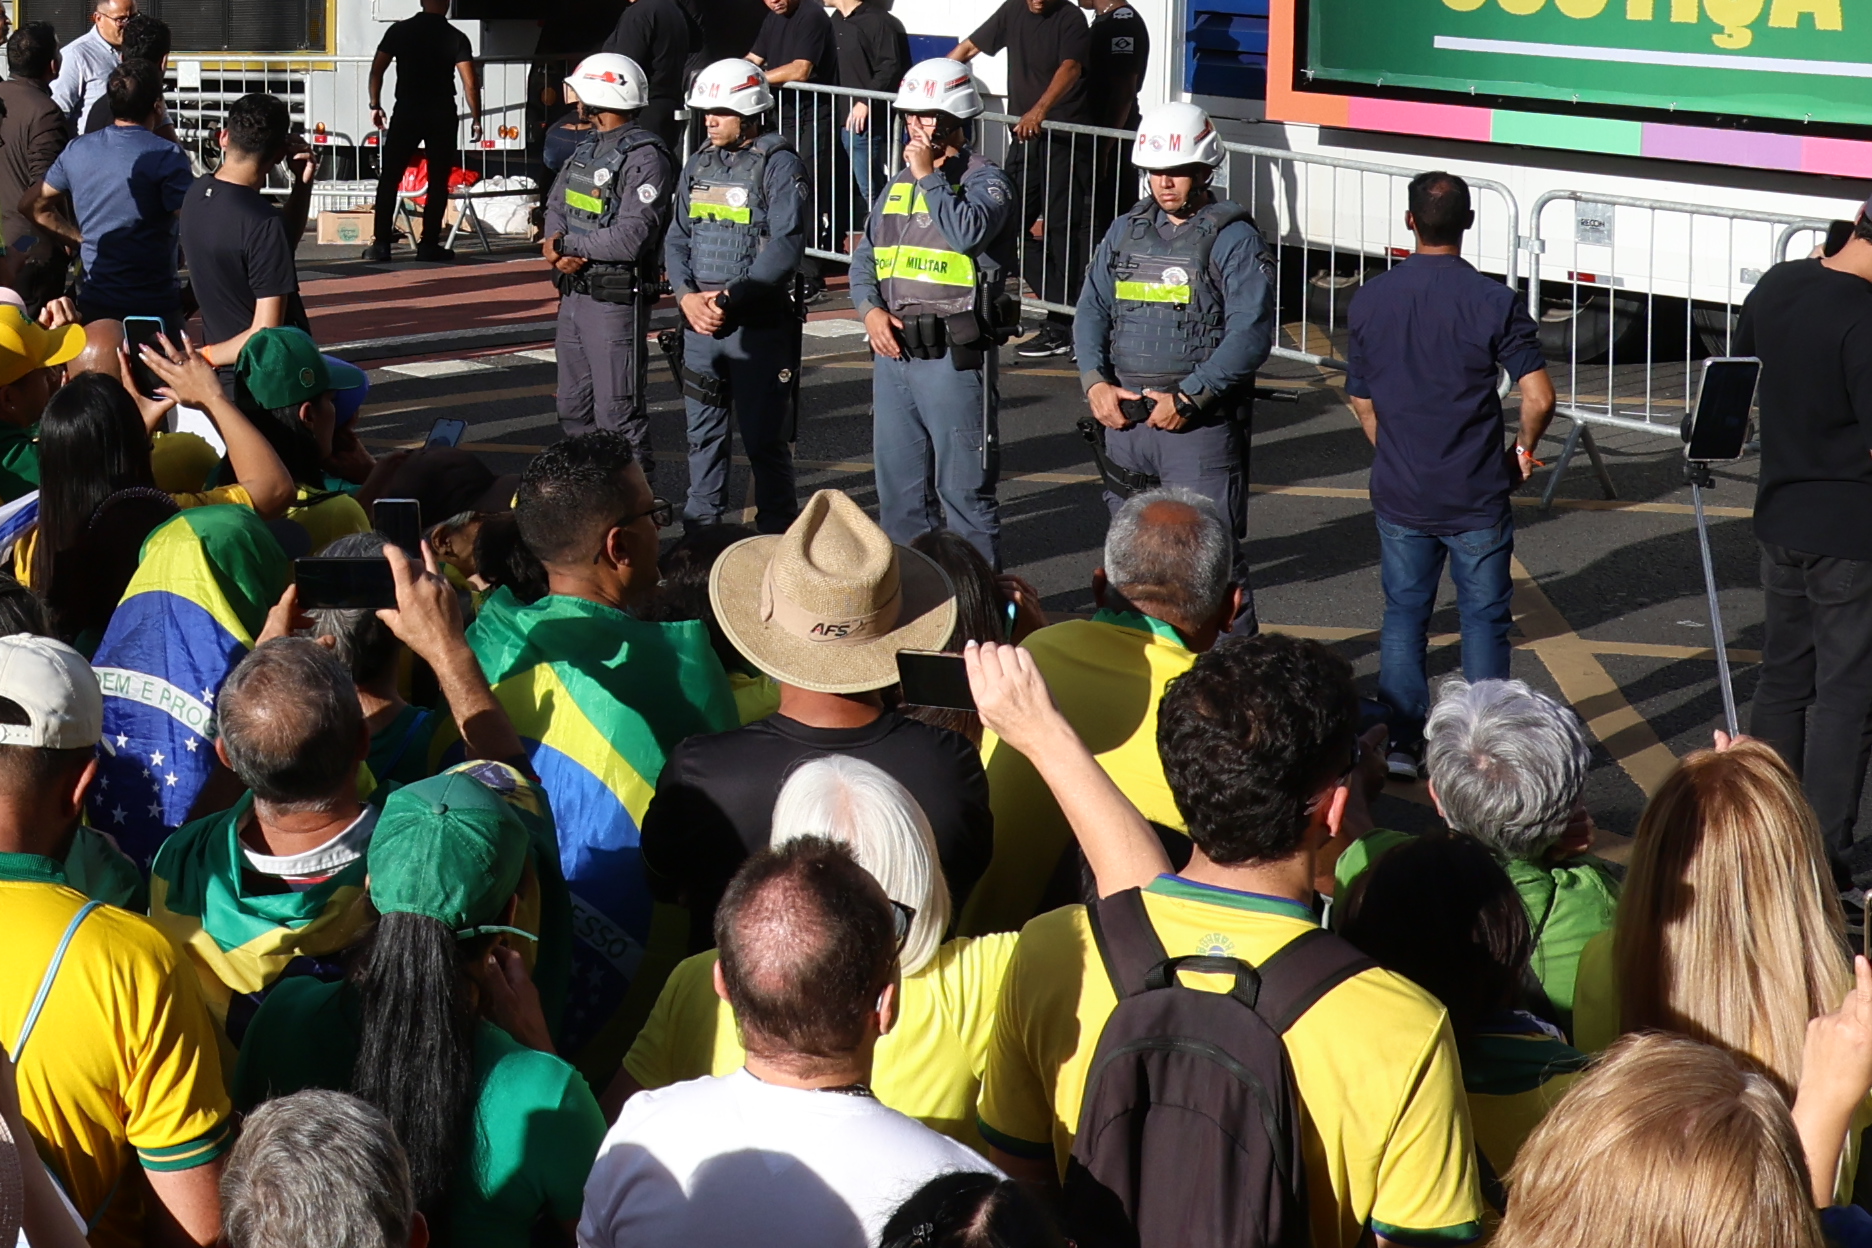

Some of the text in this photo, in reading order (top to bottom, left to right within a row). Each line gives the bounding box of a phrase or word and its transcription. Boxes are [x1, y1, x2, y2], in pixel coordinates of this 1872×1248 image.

[906, 256, 948, 274] MILITAR
[810, 622, 850, 637] AFS
[141, 680, 155, 701] E
[159, 686, 219, 737] PROG
